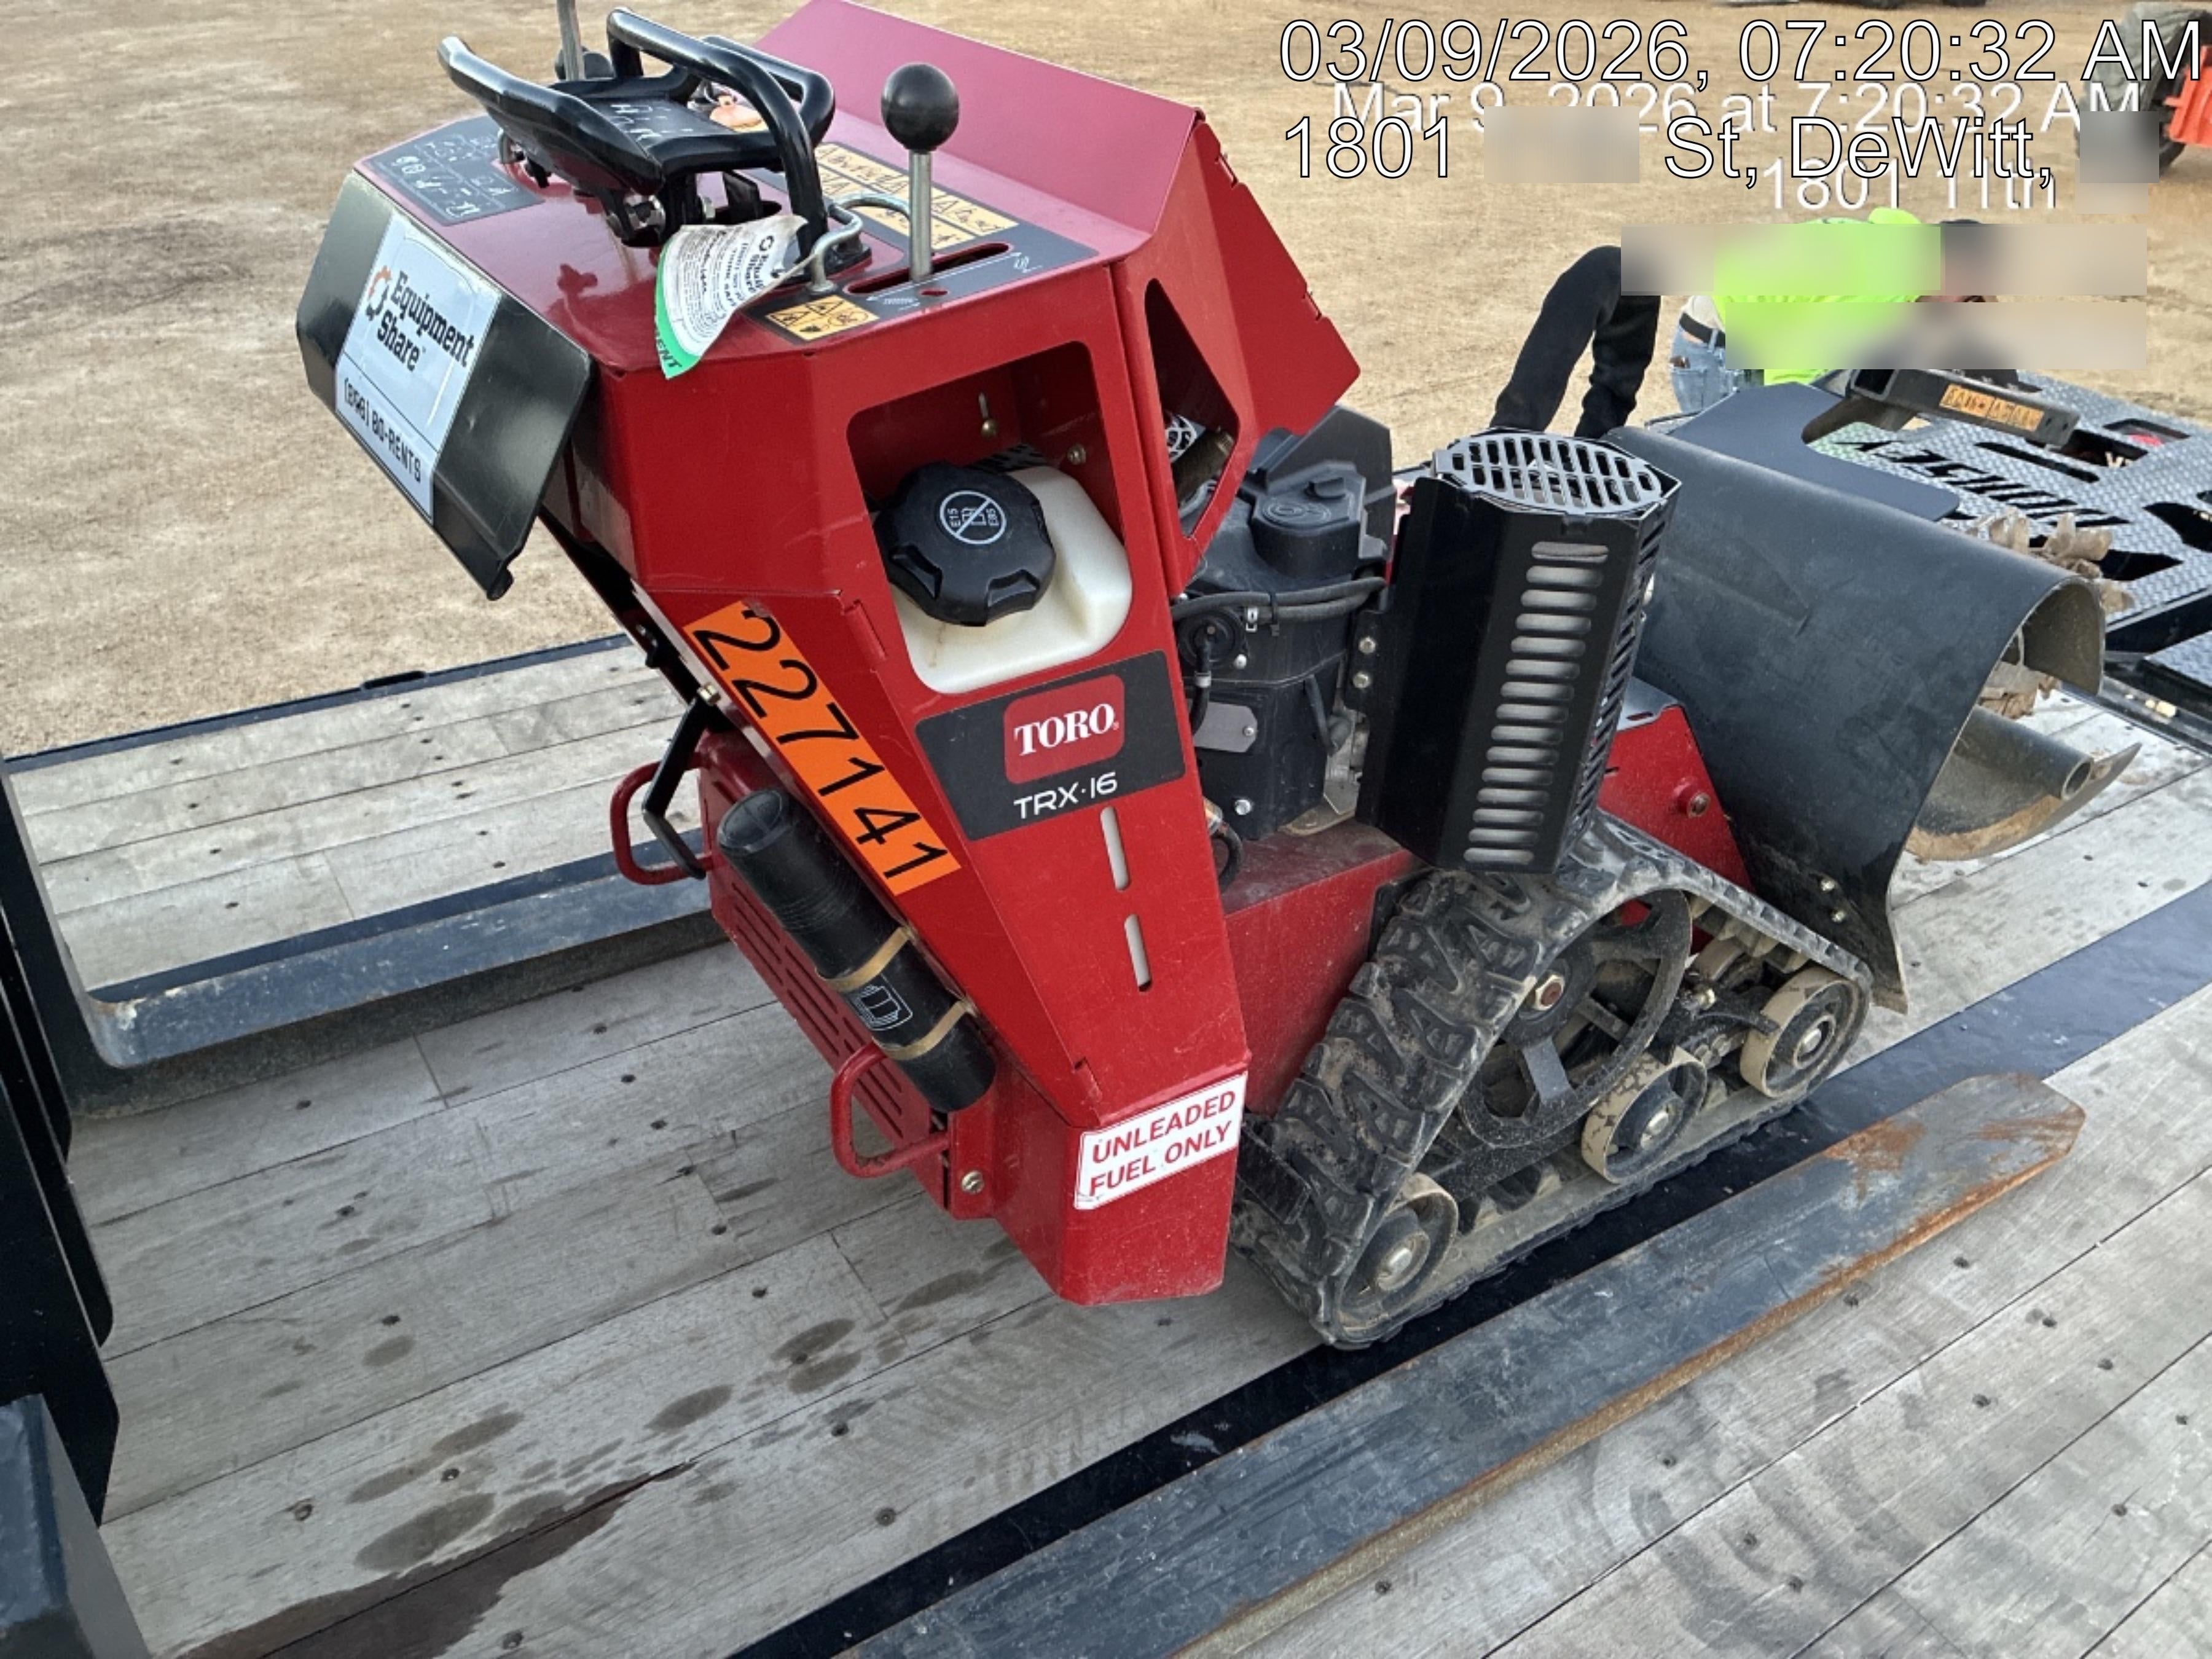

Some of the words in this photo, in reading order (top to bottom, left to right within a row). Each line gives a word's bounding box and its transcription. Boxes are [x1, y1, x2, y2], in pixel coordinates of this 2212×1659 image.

[377, 309, 422, 372] Share
[391, 270, 475, 368] Equipment
[693, 610, 948, 879] 227141
[1015, 703, 1115, 756] TORO
[1089, 1155, 1156, 1196] FUEL
[1164, 1120, 1232, 1163] ONLY
[1092, 1091, 1236, 1163] UNLEADED
